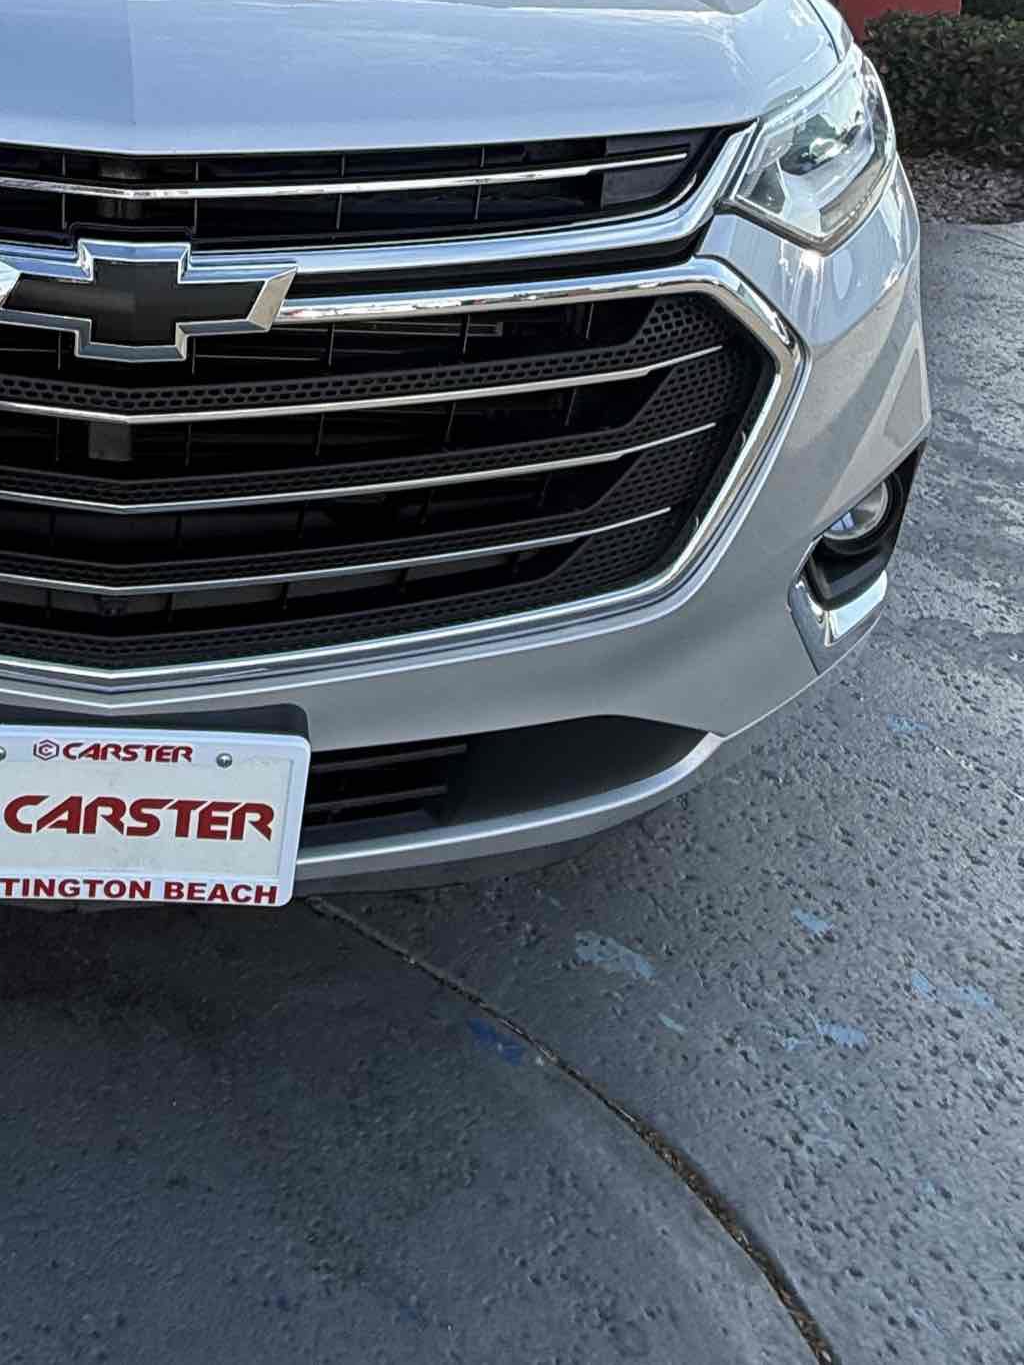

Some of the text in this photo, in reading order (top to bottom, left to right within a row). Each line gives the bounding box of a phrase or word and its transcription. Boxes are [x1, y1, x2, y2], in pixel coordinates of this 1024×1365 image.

[62, 741, 193, 763] CARSTER
[3, 794, 275, 842] CARSTER
[163, 881, 278, 904] BEACH
